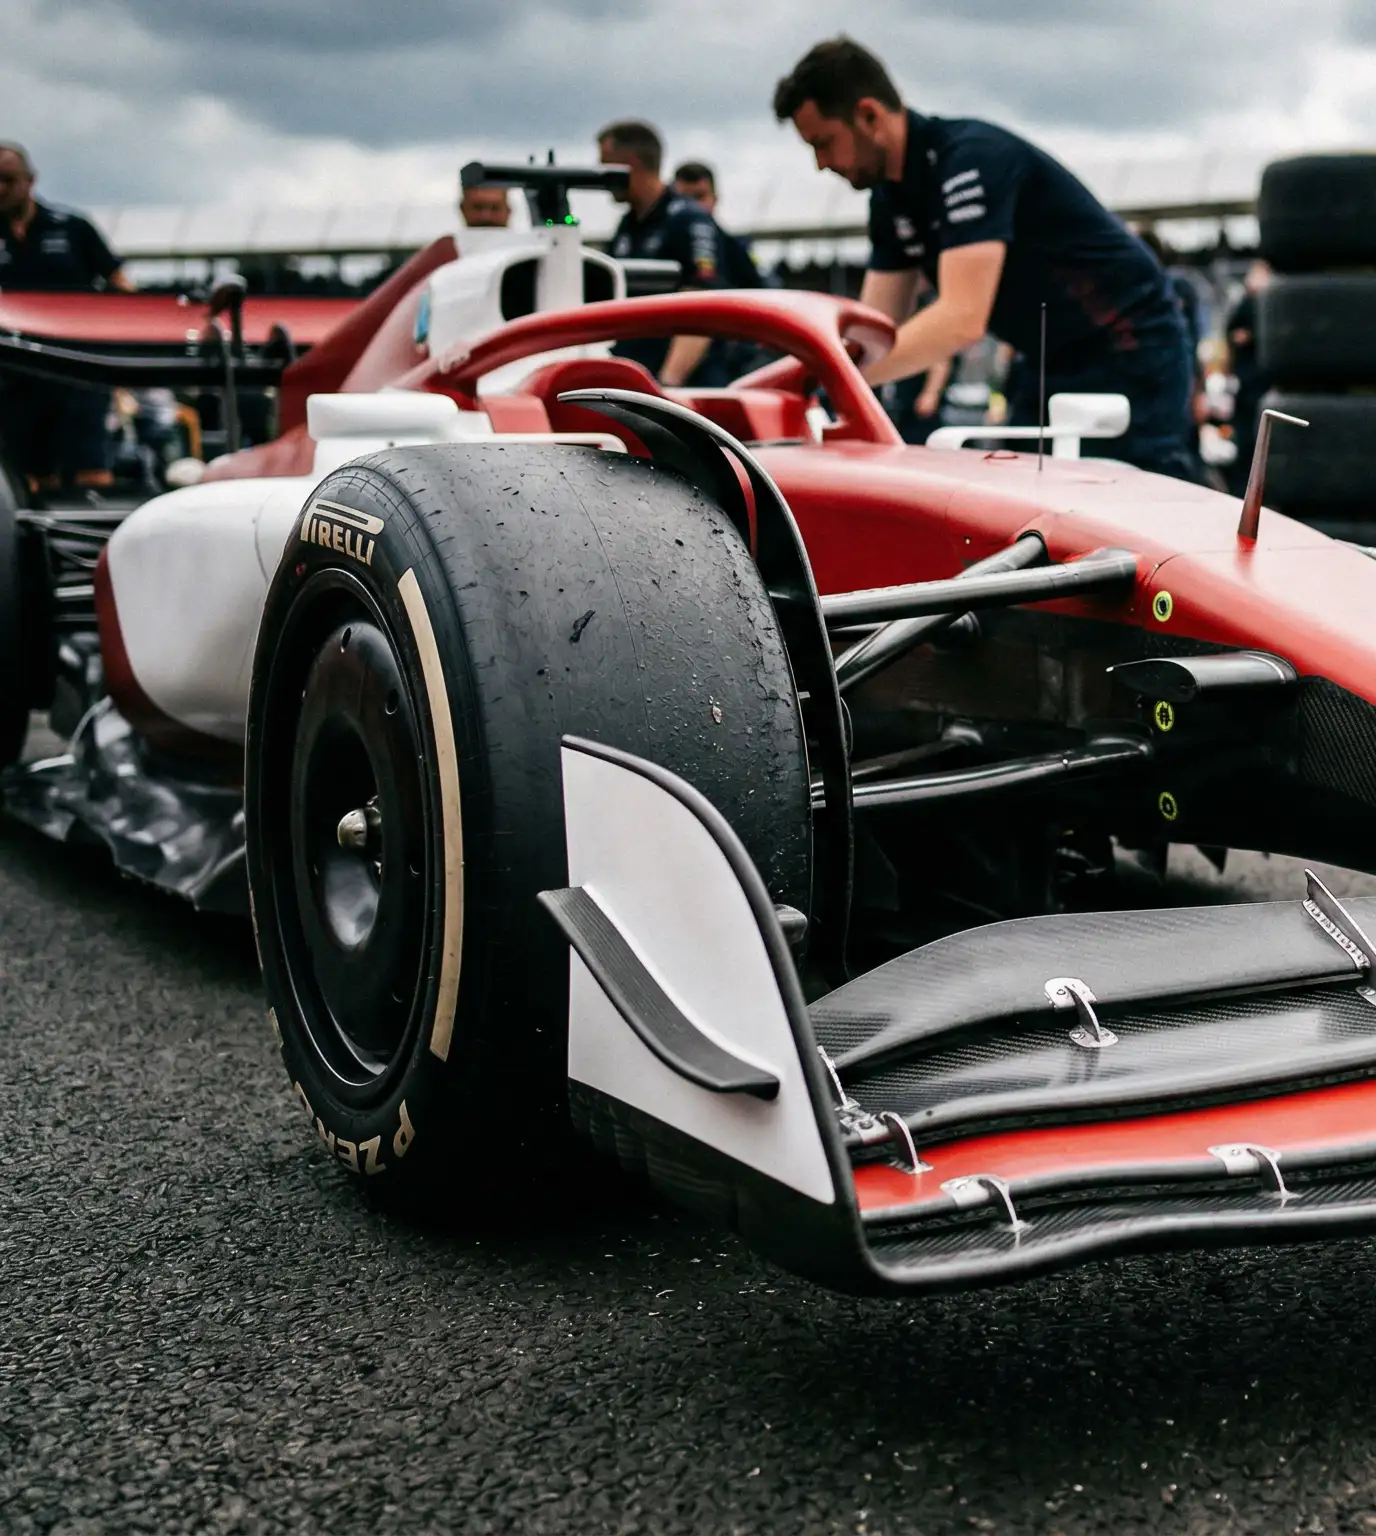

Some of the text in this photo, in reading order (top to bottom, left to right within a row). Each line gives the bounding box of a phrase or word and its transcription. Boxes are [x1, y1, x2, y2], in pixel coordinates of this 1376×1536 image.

[300, 498, 385, 567] PIRELLI
[294, 1080, 416, 1177] P ZER
